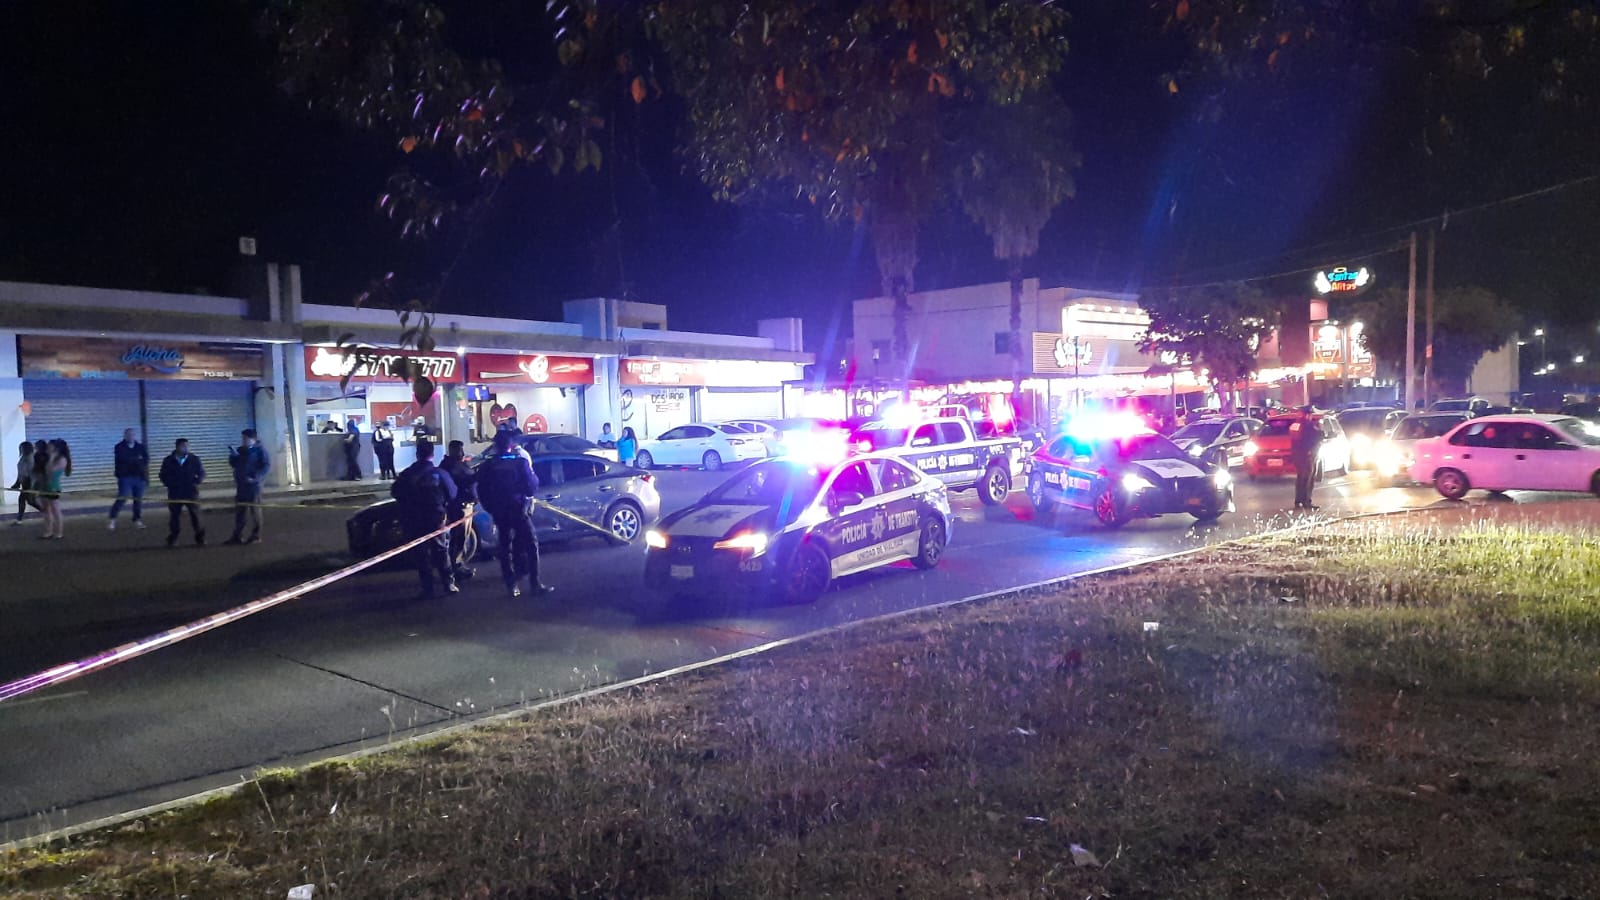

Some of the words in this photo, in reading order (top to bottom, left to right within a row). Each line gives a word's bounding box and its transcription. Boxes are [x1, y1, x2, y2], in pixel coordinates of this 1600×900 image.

[1331, 282, 1357, 292] Alitas
[841, 519, 867, 545] POLICÍA
[888, 514, 895, 531] DE
